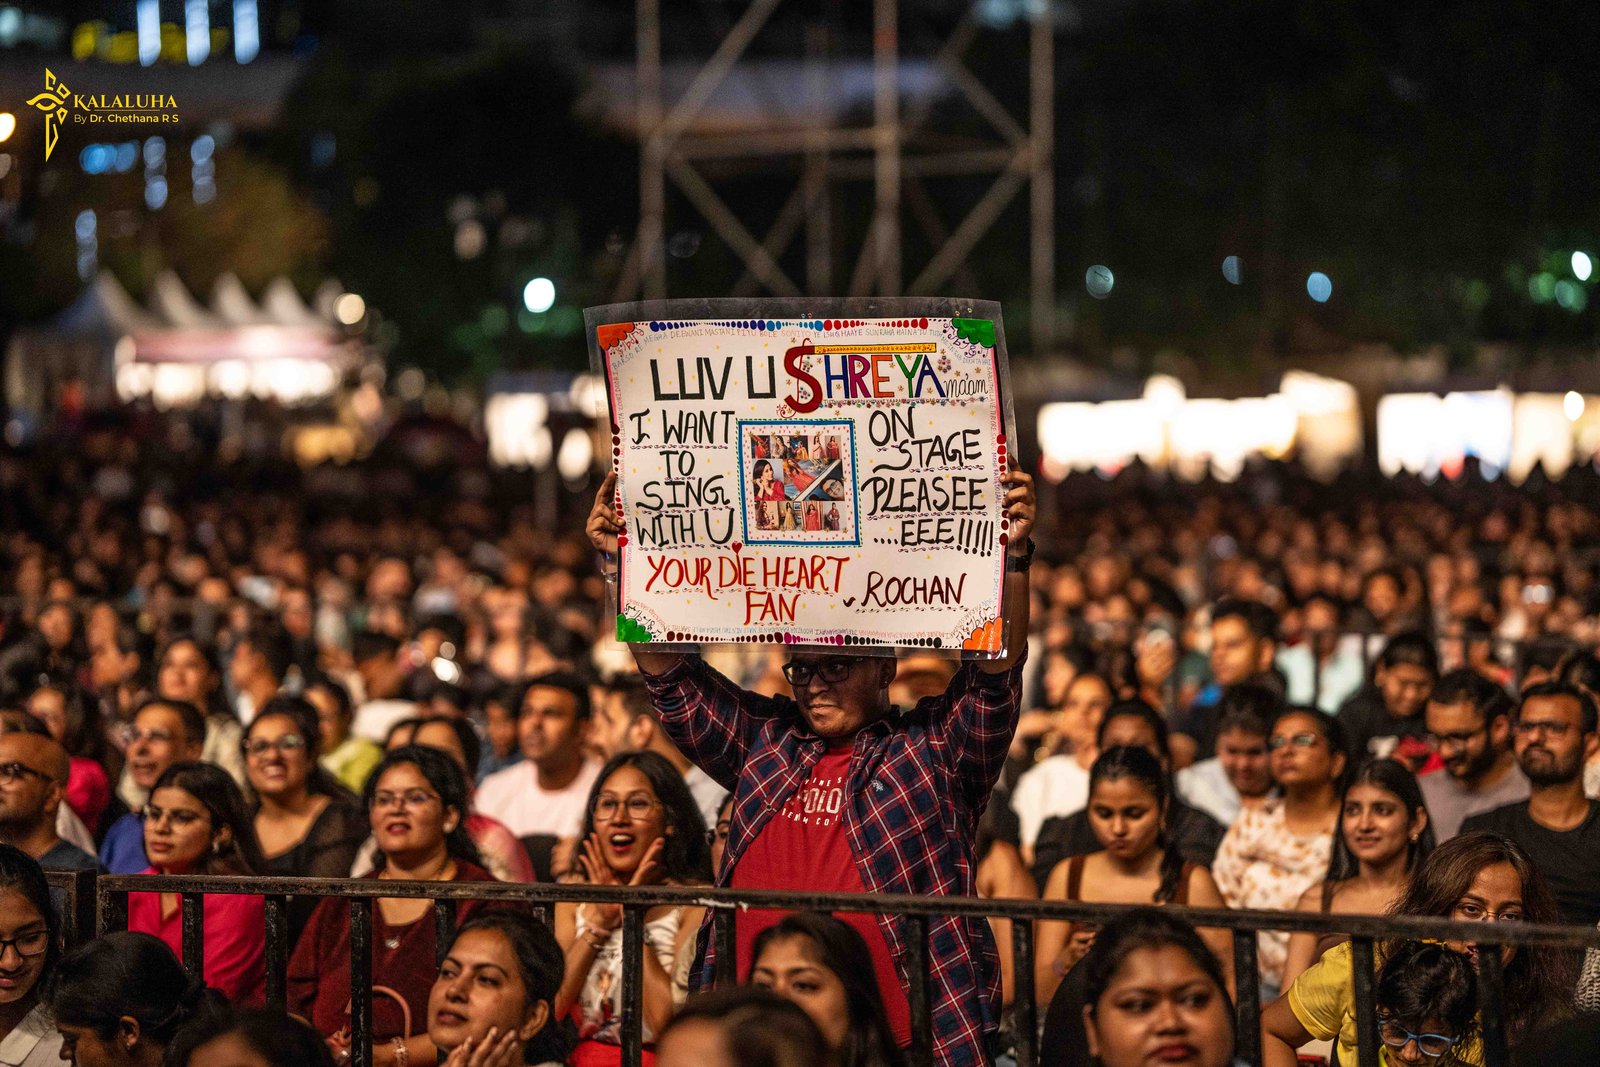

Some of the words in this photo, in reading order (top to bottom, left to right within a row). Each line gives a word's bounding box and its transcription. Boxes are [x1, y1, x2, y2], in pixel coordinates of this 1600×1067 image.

[704, 328, 735, 337] MASTANI
[650, 356, 734, 402] LUV
[745, 355, 777, 399] U
[783, 345, 947, 414] SHREYA
[629, 408, 651, 445] I
[662, 409, 736, 444] WANT
[868, 406, 916, 447] ON
[659, 450, 696, 479] TO
[872, 429, 983, 474] STAGE
[636, 474, 731, 511] SING
[861, 476, 989, 516] PLEASEE
[635, 509, 696, 548] WITH
[704, 507, 735, 545] U
[645, 554, 719, 600] YOUR
[718, 552, 757, 588] DIE
[762, 554, 851, 593] HEART
[861, 571, 968, 608] ROCHAN
[743, 590, 802, 626] FAN
